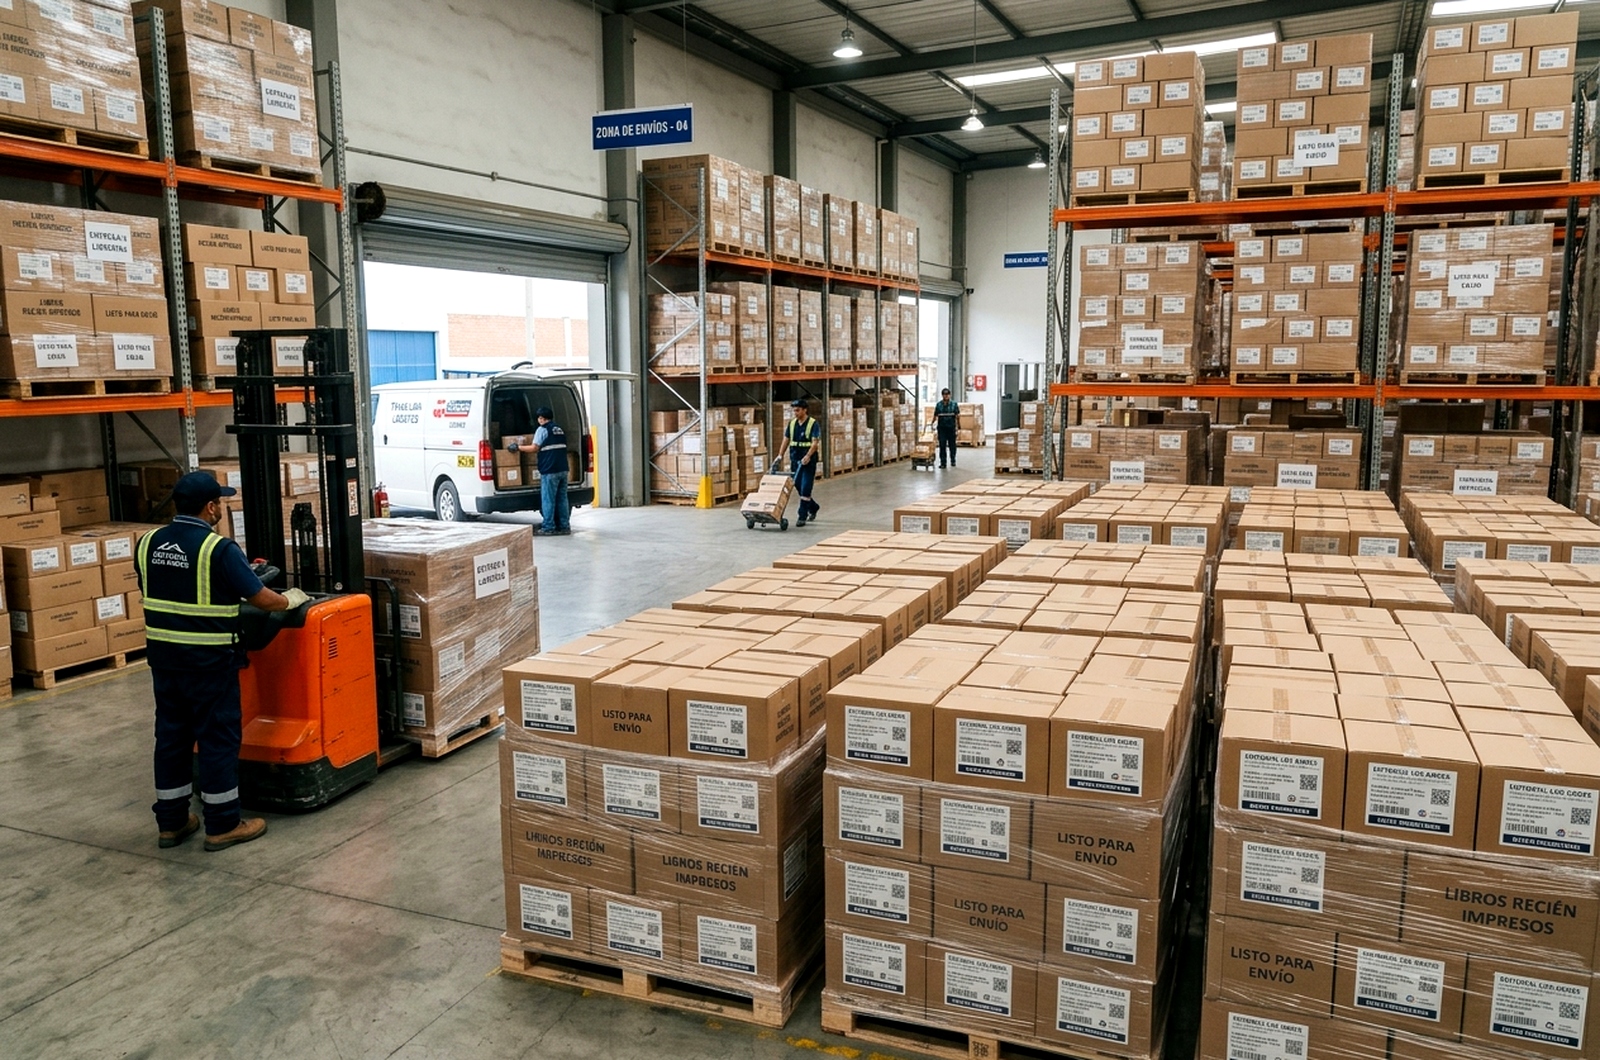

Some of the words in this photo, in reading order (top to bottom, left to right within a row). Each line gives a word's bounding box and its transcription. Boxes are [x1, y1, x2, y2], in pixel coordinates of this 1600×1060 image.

[622, 124, 634, 136] DE
[628, 711, 653, 723] PARA
[1057, 832, 1095, 847] LISTO
[1098, 837, 1135, 853] PARA
[953, 898, 988, 914] LISTO
[991, 904, 1025, 920] PARA
[1444, 886, 1507, 908] LIBROS
[1512, 896, 1577, 918] RECIÉN
[1461, 909, 1554, 935] IMPRESOS
[1230, 946, 1271, 964] LISTO
[1275, 954, 1315, 972] PARA
[1248, 965, 1295, 984] ENVÍO
